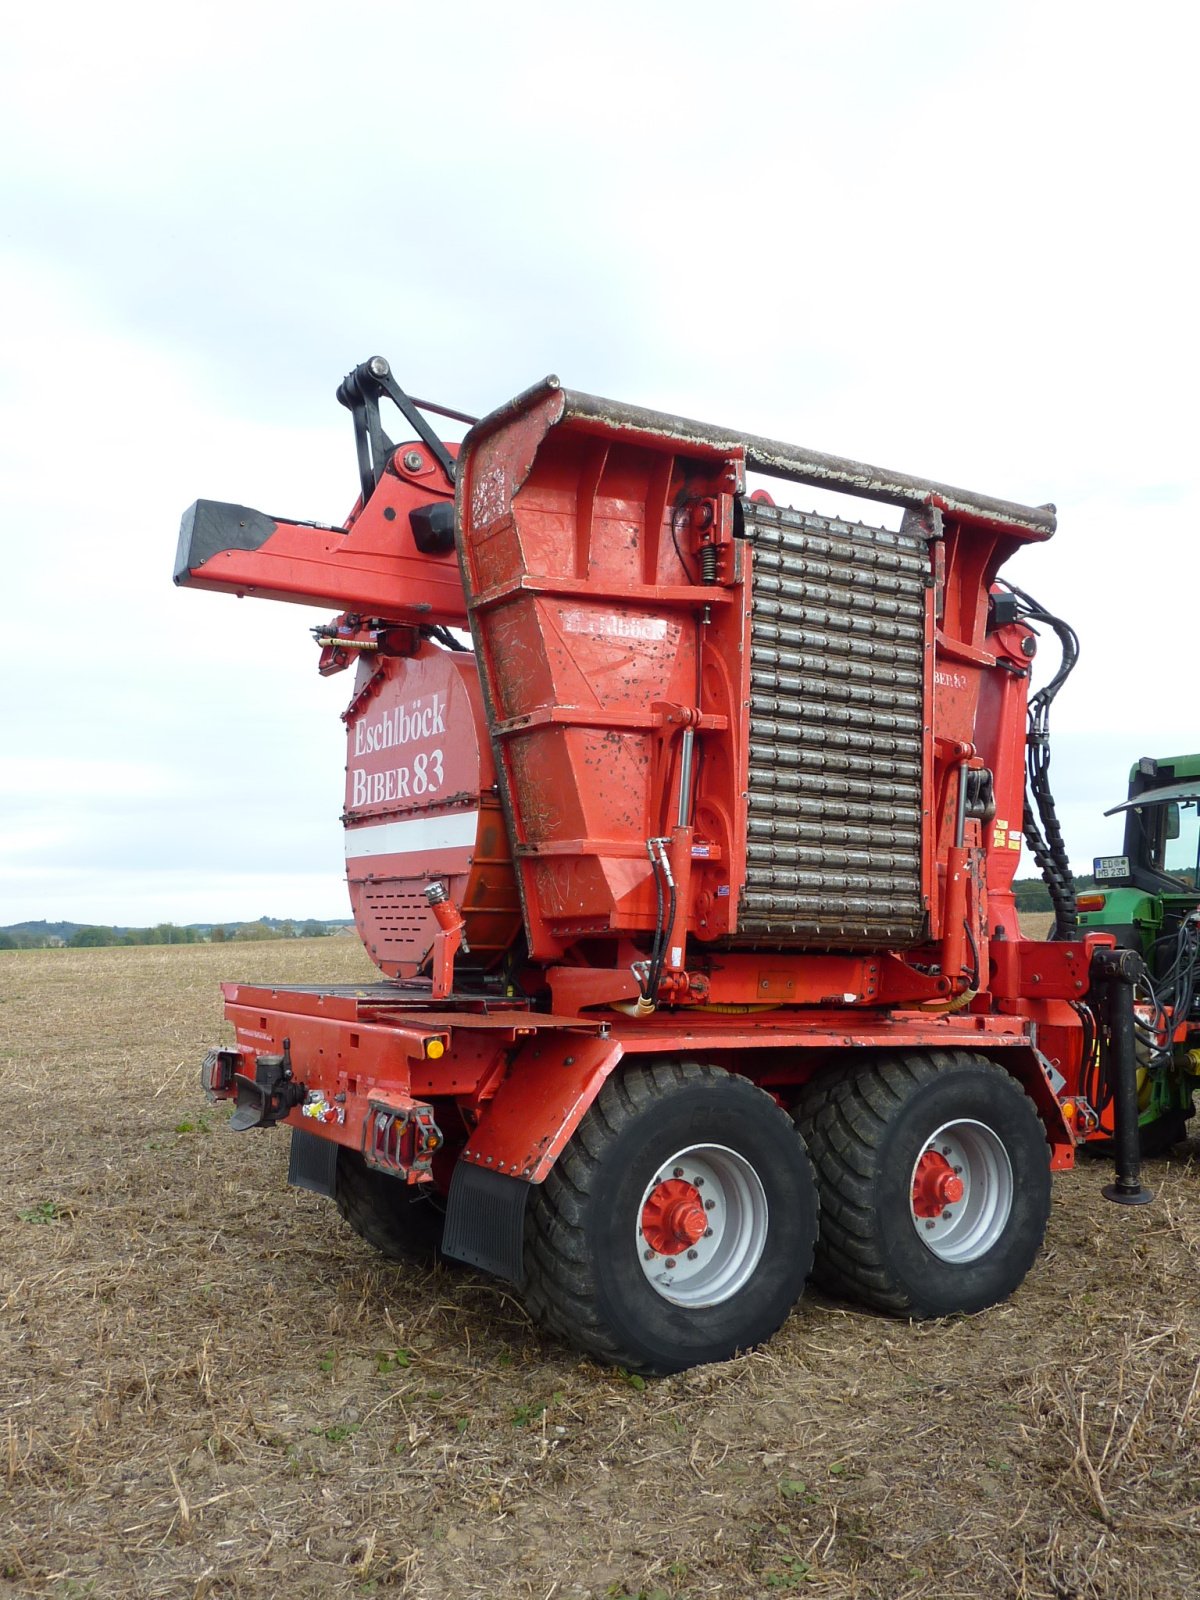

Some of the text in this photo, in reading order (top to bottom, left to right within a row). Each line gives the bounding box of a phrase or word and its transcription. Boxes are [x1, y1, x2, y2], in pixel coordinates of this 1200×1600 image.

[354, 694, 446, 757] Eschlböck
[352, 749, 444, 808] BIBER 83
